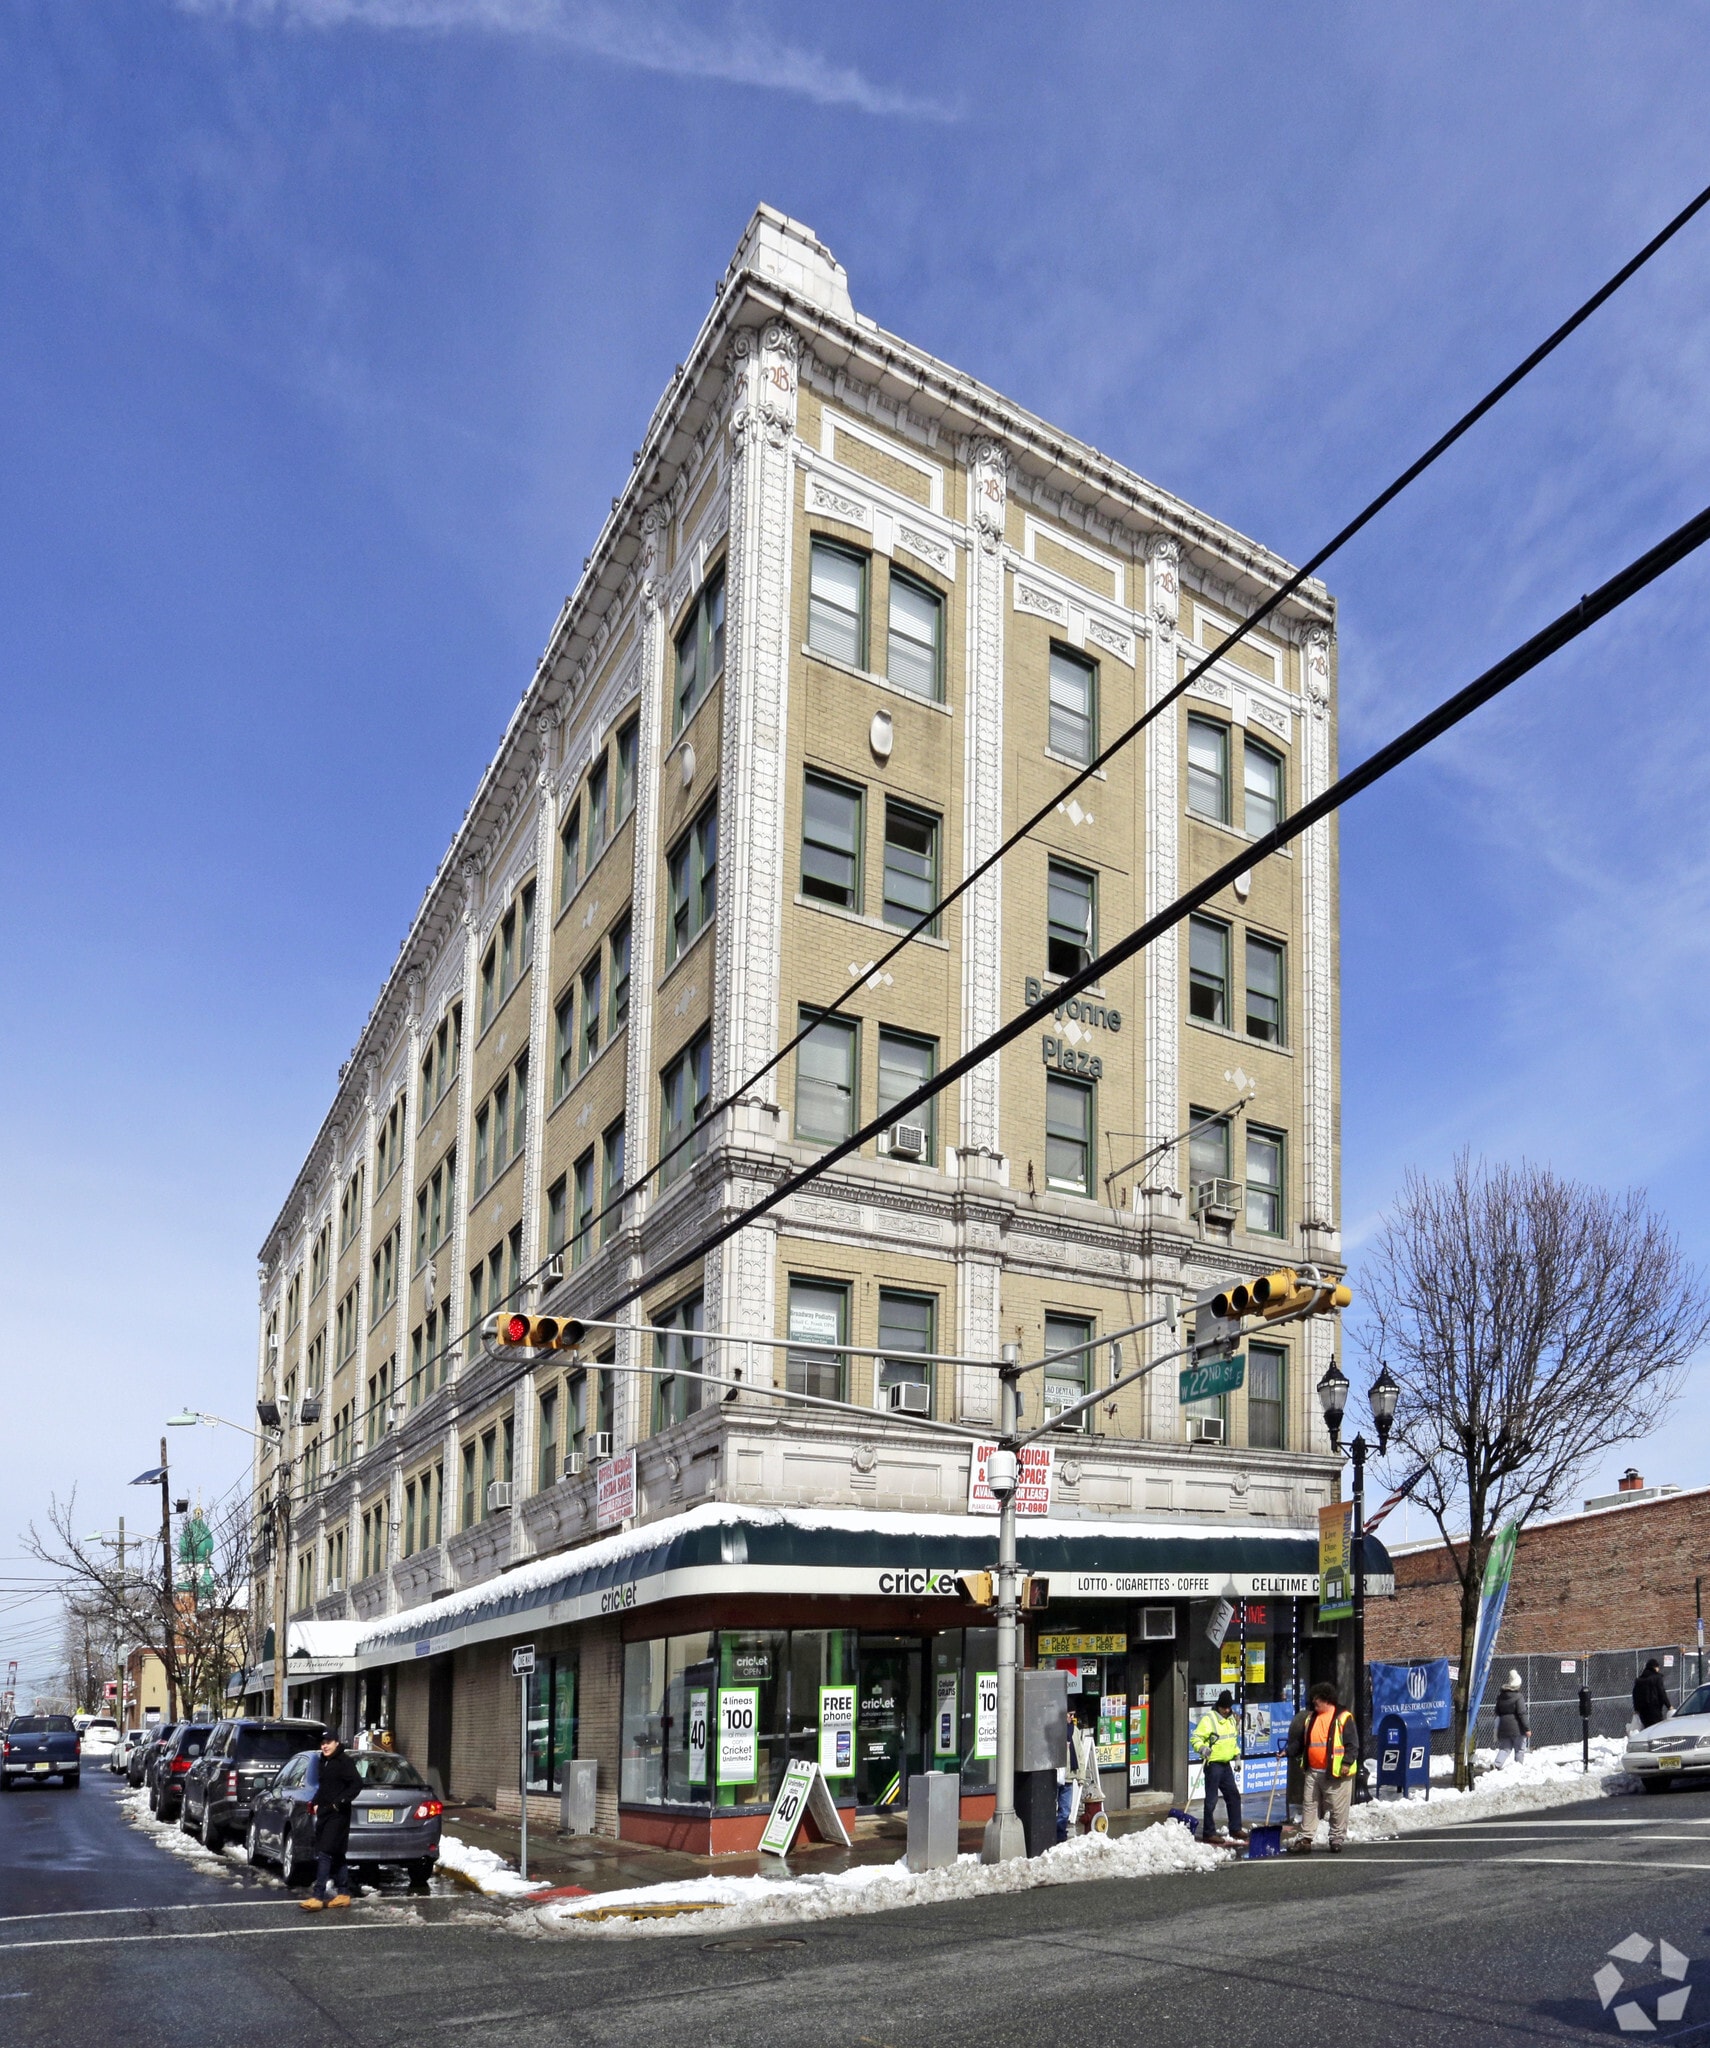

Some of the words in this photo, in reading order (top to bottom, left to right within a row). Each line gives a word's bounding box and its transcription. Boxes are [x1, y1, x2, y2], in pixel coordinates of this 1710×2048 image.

[1025, 976, 1121, 1031] Byonne
[1042, 1034, 1102, 1079] Plaza
[1181, 1386, 1189, 1400] W
[1190, 1365, 1221, 1396] 22ND
[1236, 1371, 1242, 1385] E
[978, 1468, 985, 1482] &
[1018, 1468, 1047, 1485] SPACE
[1015, 1488, 1025, 1499] OR
[1027, 1488, 1048, 1500] LEASE
[1341, 1510, 1352, 1570] BAYONNE
[1078, 1578, 1107, 1591] LOTTO
[1116, 1578, 1169, 1591] CIGARETTES
[1177, 1578, 1209, 1591] COFFEE
[1252, 1578, 1308, 1592] CELLTIME
[601, 1580, 637, 1613] cricket
[1212, 1603, 1229, 1640] ATM
[1052, 1637, 1071, 1645] PLAY
[1096, 1636, 1114, 1645] PLAY
[1052, 1644, 1070, 1652] HERE
[1096, 1642, 1113, 1651] HERE
[737, 1656, 768, 1666] cricket
[743, 1668, 761, 1676] OPEN
[979, 1680, 985, 1689] 4
[937, 1688, 956, 1697] GRATIS
[722, 1697, 728, 1705] 4
[823, 1696, 852, 1711] FREE
[861, 1697, 895, 1709] cricket
[1381, 1704, 1400, 1712] PENTA
[1401, 1701, 1432, 1711] RESTORATION
[1432, 1700, 1448, 1709] CORP.
[823, 1712, 852, 1722] phone
[1245, 1733, 1256, 1748] 19
[722, 1746, 752, 1755] Cricket
[1132, 1765, 1141, 1777] 70
